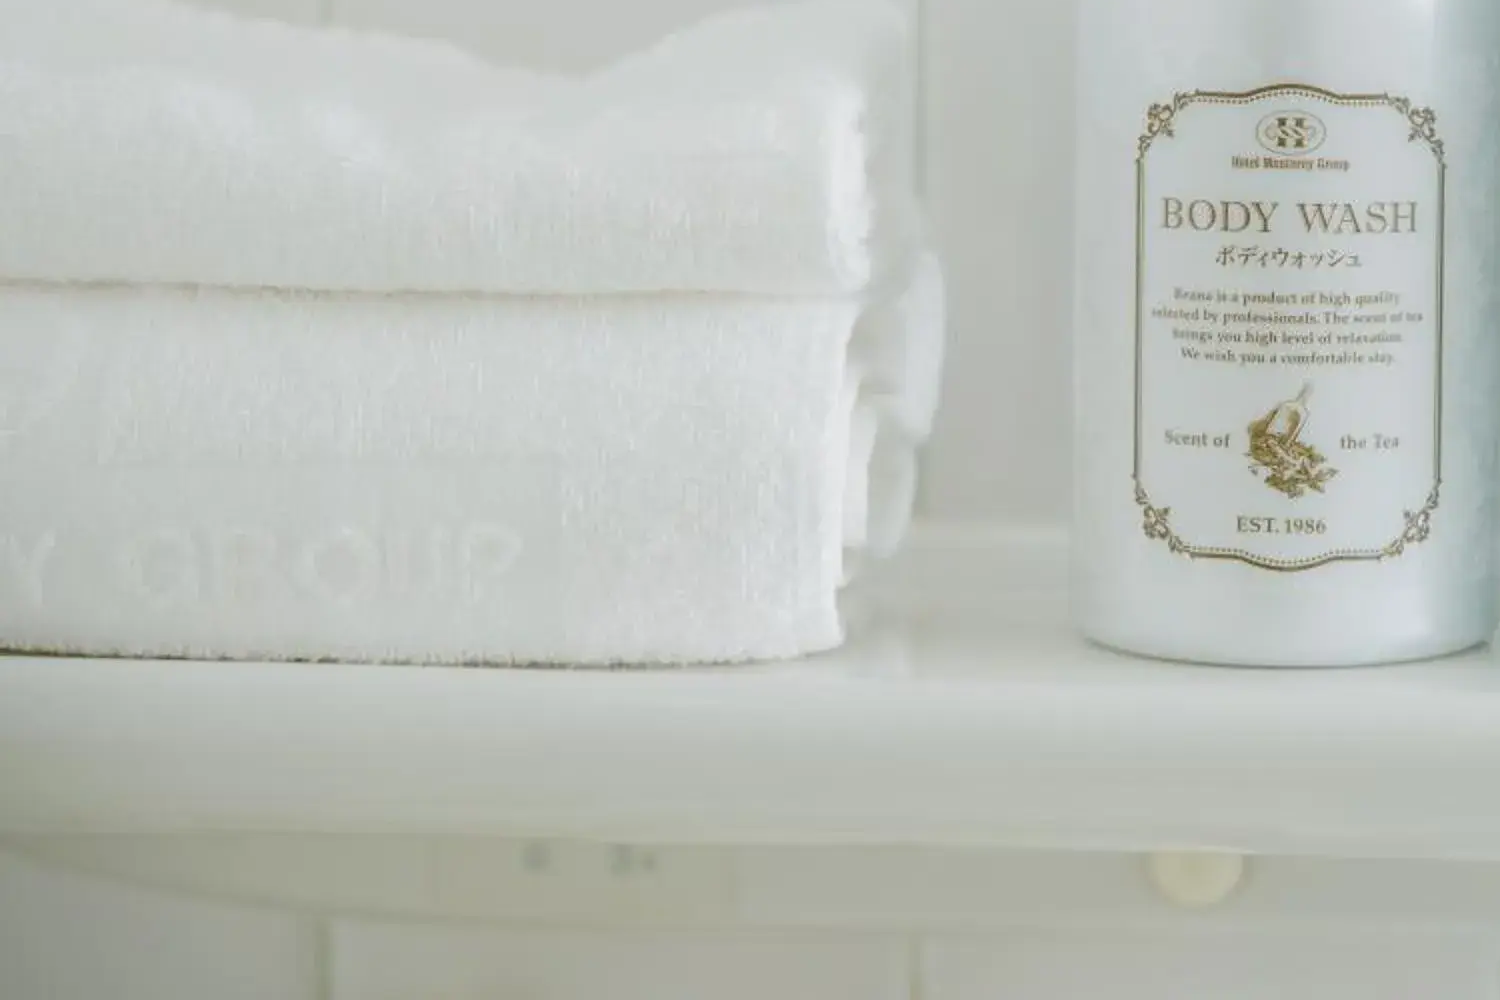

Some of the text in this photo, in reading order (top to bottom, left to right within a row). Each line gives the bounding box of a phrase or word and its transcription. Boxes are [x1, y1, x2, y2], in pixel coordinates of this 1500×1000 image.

[1161, 197, 1419, 234] BODY WASH
[1215, 244, 1362, 269] ボディウォッシュ
[1243, 289, 1297, 306] product
[1164, 428, 1400, 450] Scent of the Tea
[1236, 515, 1327, 535] EST. 1986
